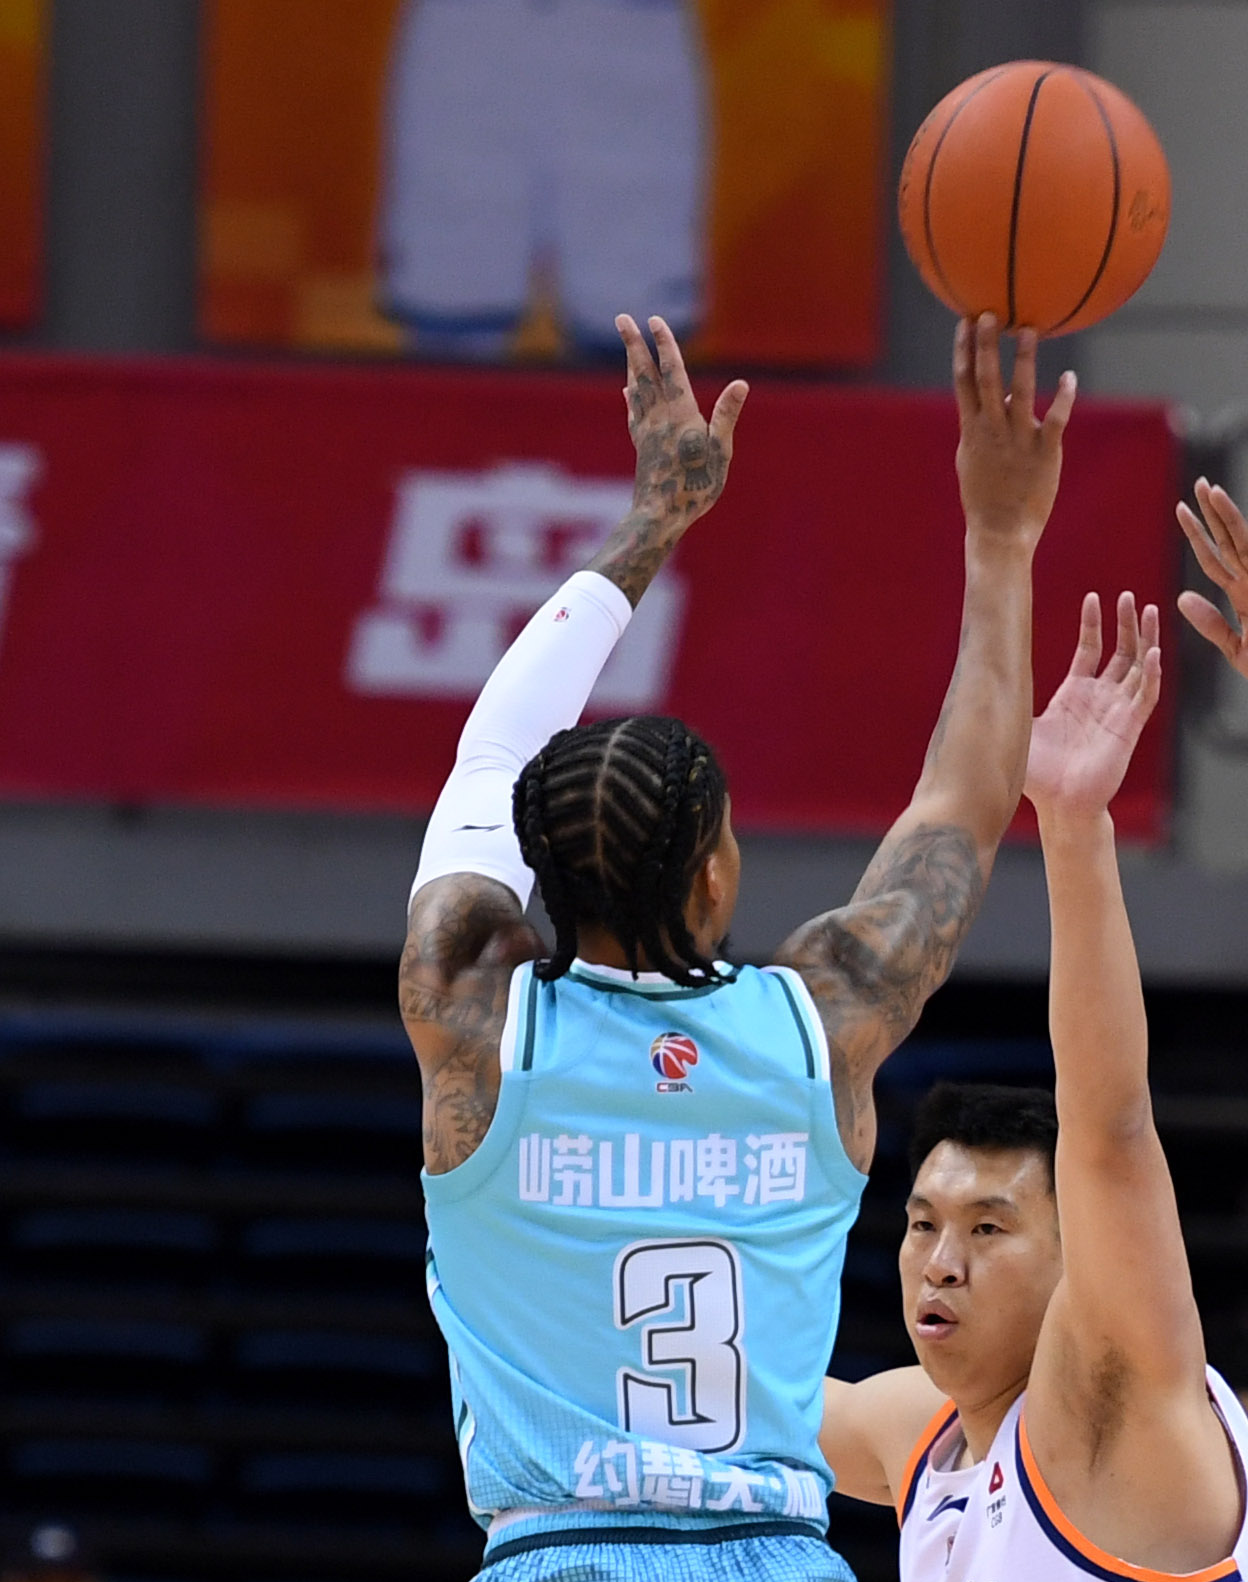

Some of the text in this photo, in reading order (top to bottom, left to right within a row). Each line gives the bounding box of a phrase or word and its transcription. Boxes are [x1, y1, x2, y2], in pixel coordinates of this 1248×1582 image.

[656, 1082, 694, 1093] CBA
[519, 1132, 808, 1208] 崂山啤酒
[612, 1236, 747, 1456] 3
